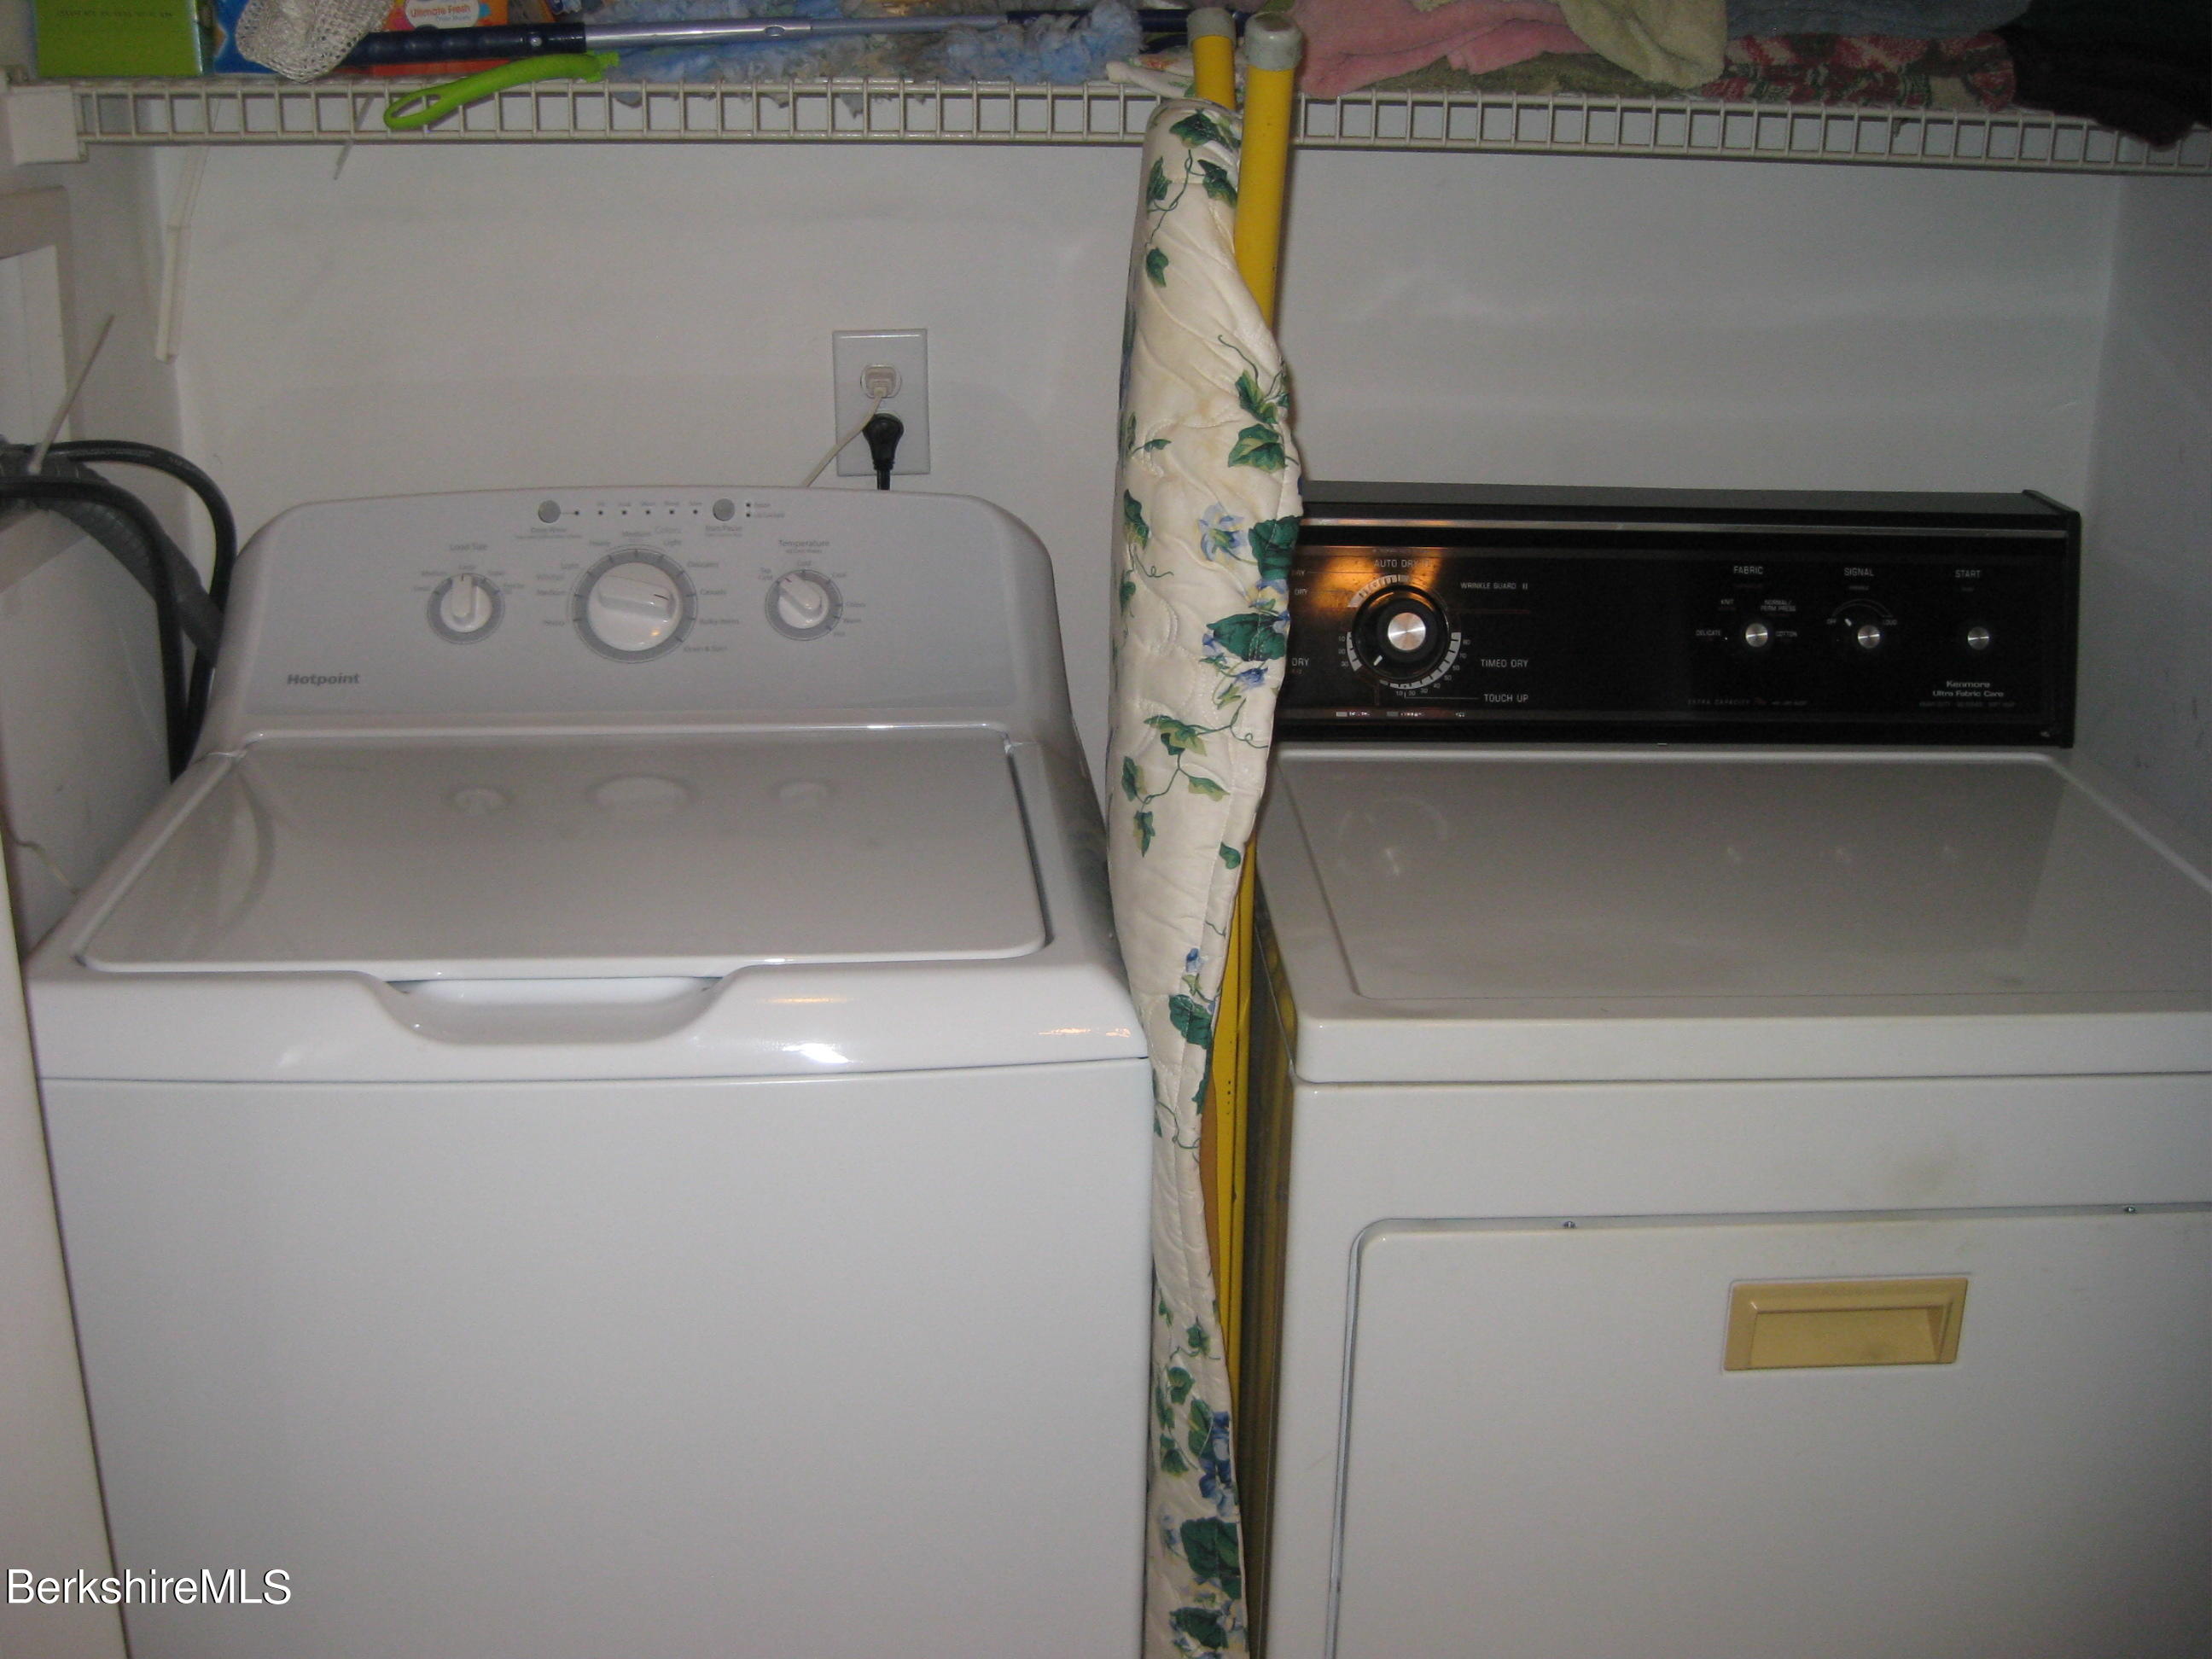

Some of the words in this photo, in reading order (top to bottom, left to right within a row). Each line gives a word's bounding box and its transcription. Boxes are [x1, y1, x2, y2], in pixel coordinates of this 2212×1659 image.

[448, 4, 471, 13] Fresh
[778, 539, 830, 548] Temperature
[1374, 559, 1398, 568] AUTO
[1400, 559, 1418, 568] DRY
[1732, 566, 1764, 575] FABRIC
[1843, 568, 1875, 577] SIGNAL
[1954, 569, 1982, 579] START
[1291, 657, 1310, 667] DRY
[1481, 659, 1508, 668] TIMED
[1511, 659, 1529, 669] DRY
[287, 673, 360, 686] Hotpoint
[1946, 680, 1991, 689] Kenmore
[1484, 694, 1513, 703] TOUCH
[1516, 694, 1529, 703] UP
[1931, 690, 1954, 698] Ultra
[1955, 690, 1982, 698] Fabric
[1983, 690, 2005, 698] Care
